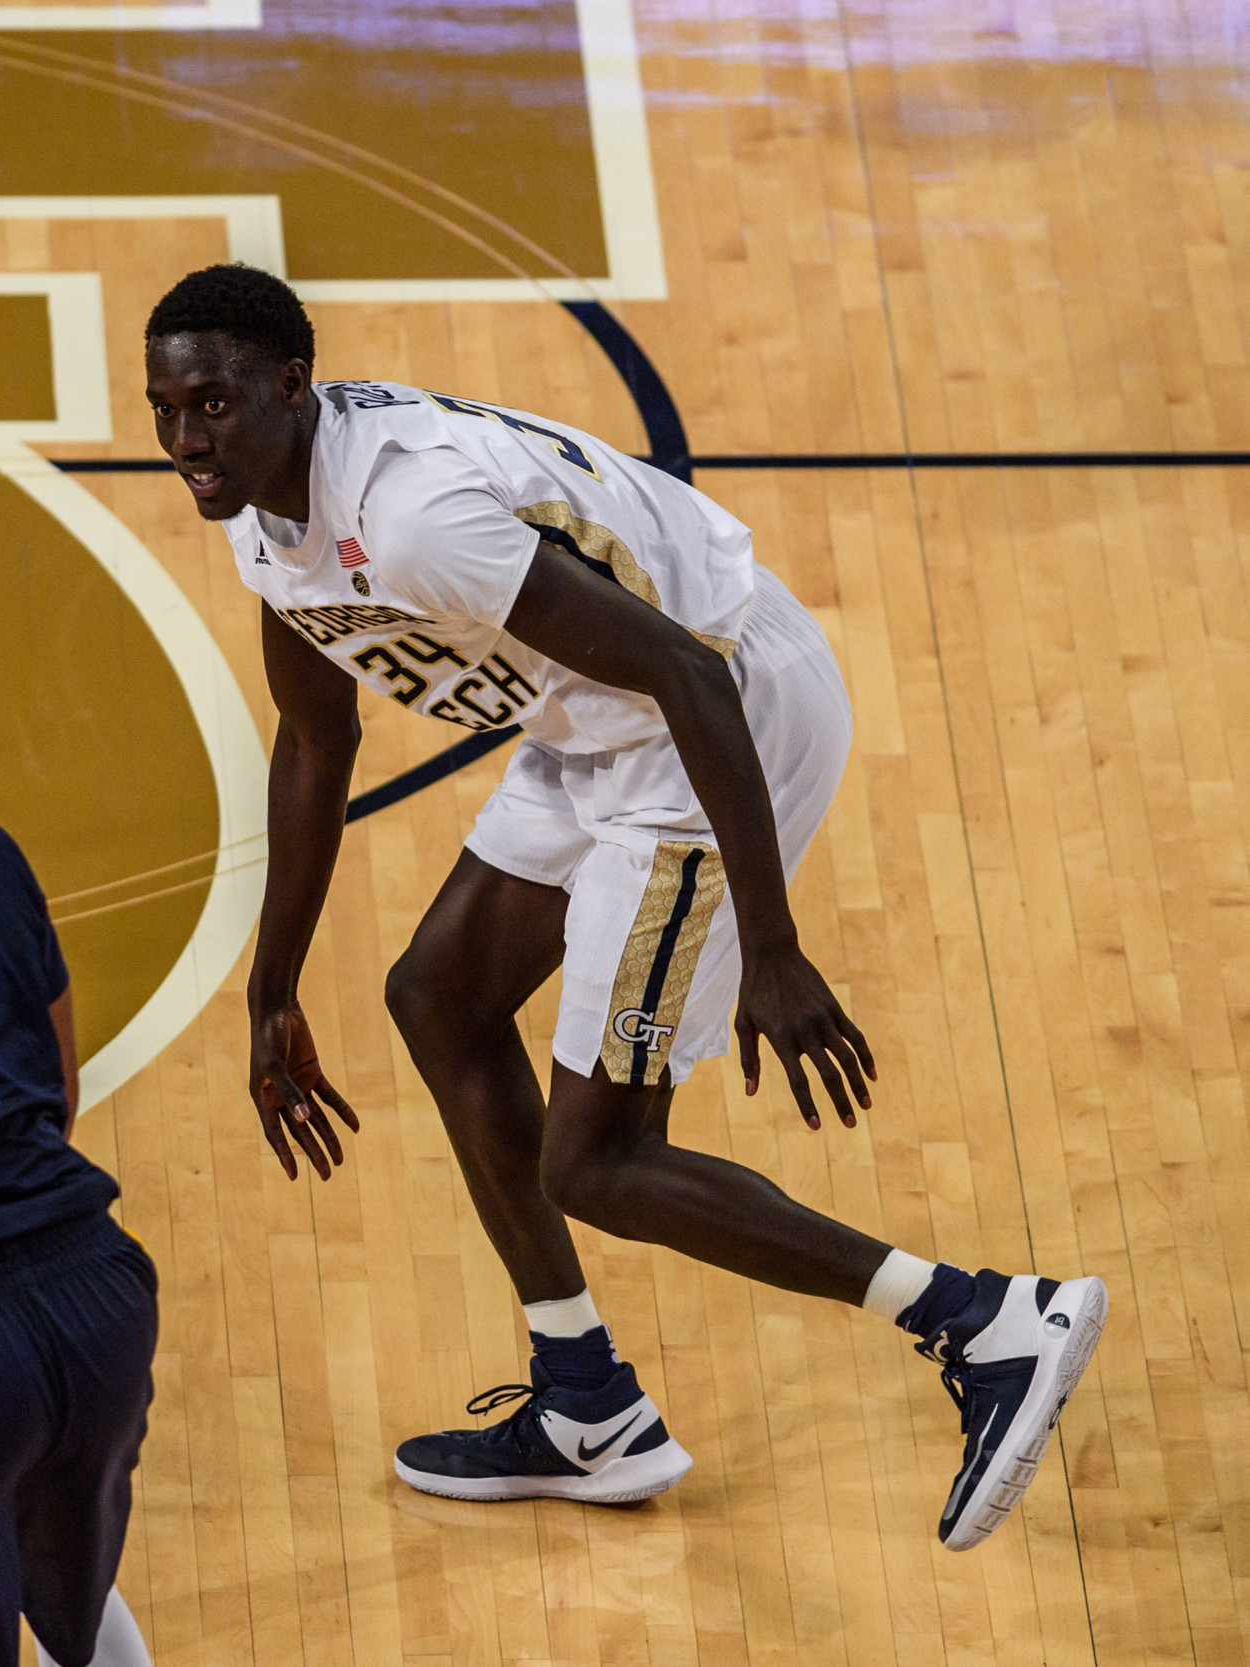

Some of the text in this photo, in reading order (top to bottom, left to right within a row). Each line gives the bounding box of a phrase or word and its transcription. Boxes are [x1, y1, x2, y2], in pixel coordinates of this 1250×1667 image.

[350, 629, 473, 708] 34
[427, 651, 541, 732] ECH
[613, 1008, 674, 1052] GT
